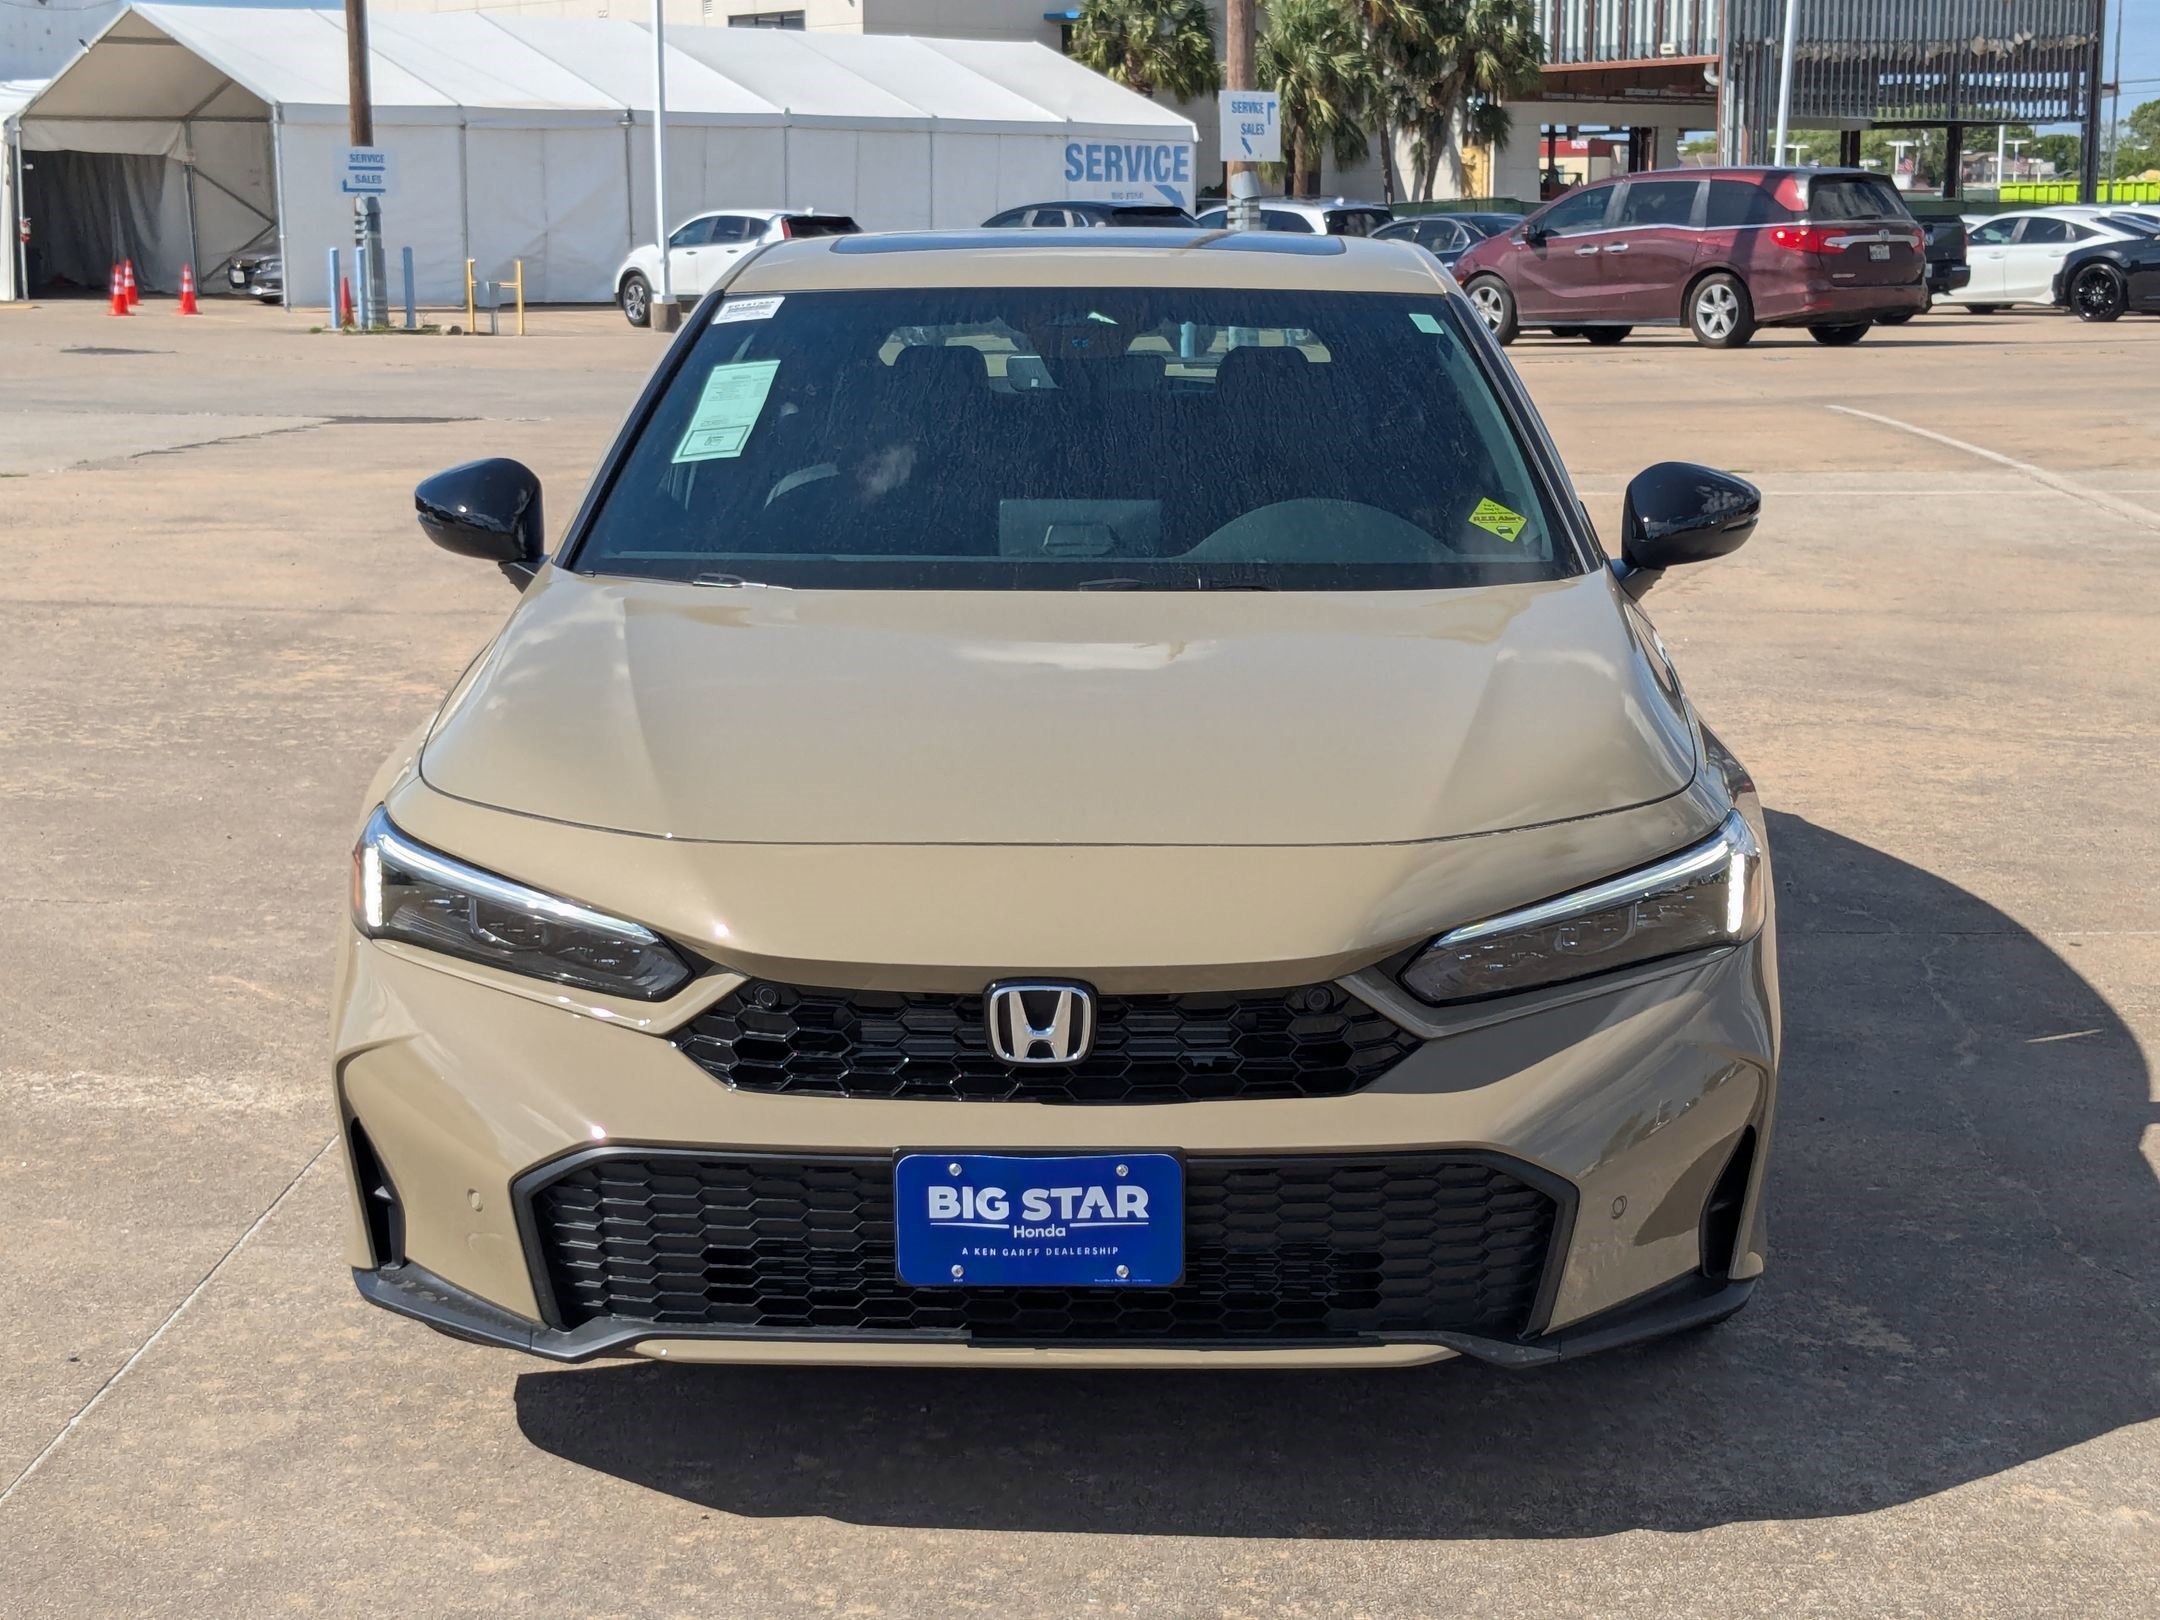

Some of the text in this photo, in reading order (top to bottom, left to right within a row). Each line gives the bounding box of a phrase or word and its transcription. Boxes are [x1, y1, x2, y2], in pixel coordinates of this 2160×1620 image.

[1231, 101, 1264, 113] SERVICE
[1240, 123, 1265, 136] SALES
[349, 154, 384, 163] SERVICE
[1065, 143, 1189, 182] SERVICE
[355, 174, 382, 184] SALES
[928, 1185, 1149, 1222] BIG STAR
[1013, 1223, 1066, 1238] Honda
[962, 1246, 1119, 1257] A KEN GARFF DEALERSHIP
